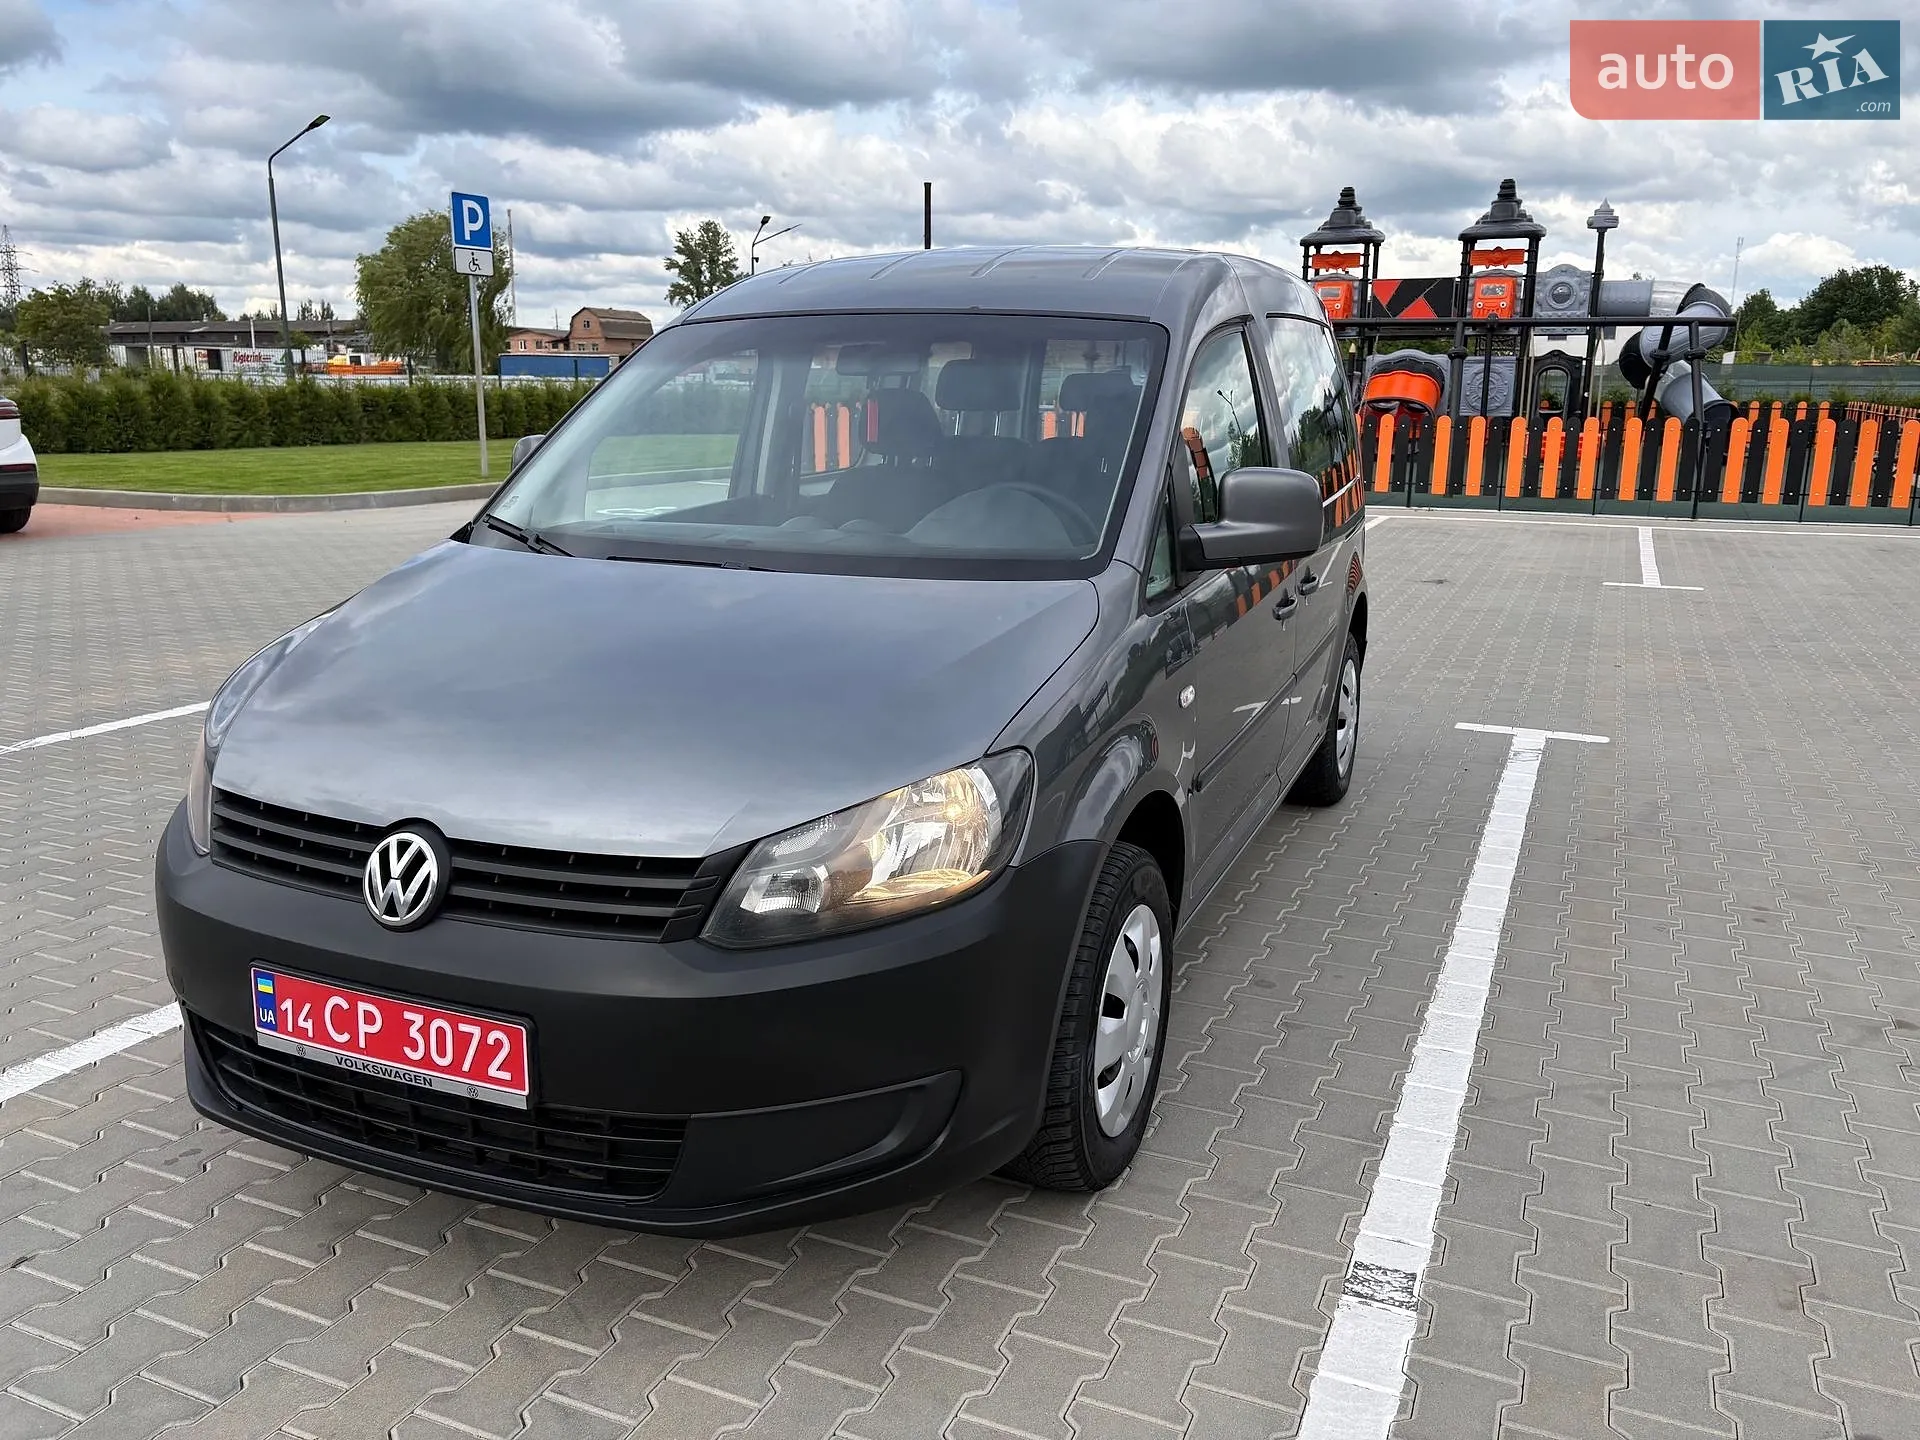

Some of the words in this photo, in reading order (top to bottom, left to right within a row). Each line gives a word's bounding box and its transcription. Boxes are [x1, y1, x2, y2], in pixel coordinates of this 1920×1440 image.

[462, 199, 484, 241] P
[259, 1007, 276, 1025] UA
[280, 998, 314, 1038] 14
[324, 995, 383, 1049] CP
[402, 1011, 512, 1081] 3072
[335, 1054, 433, 1088] VOLKSWAGEN
